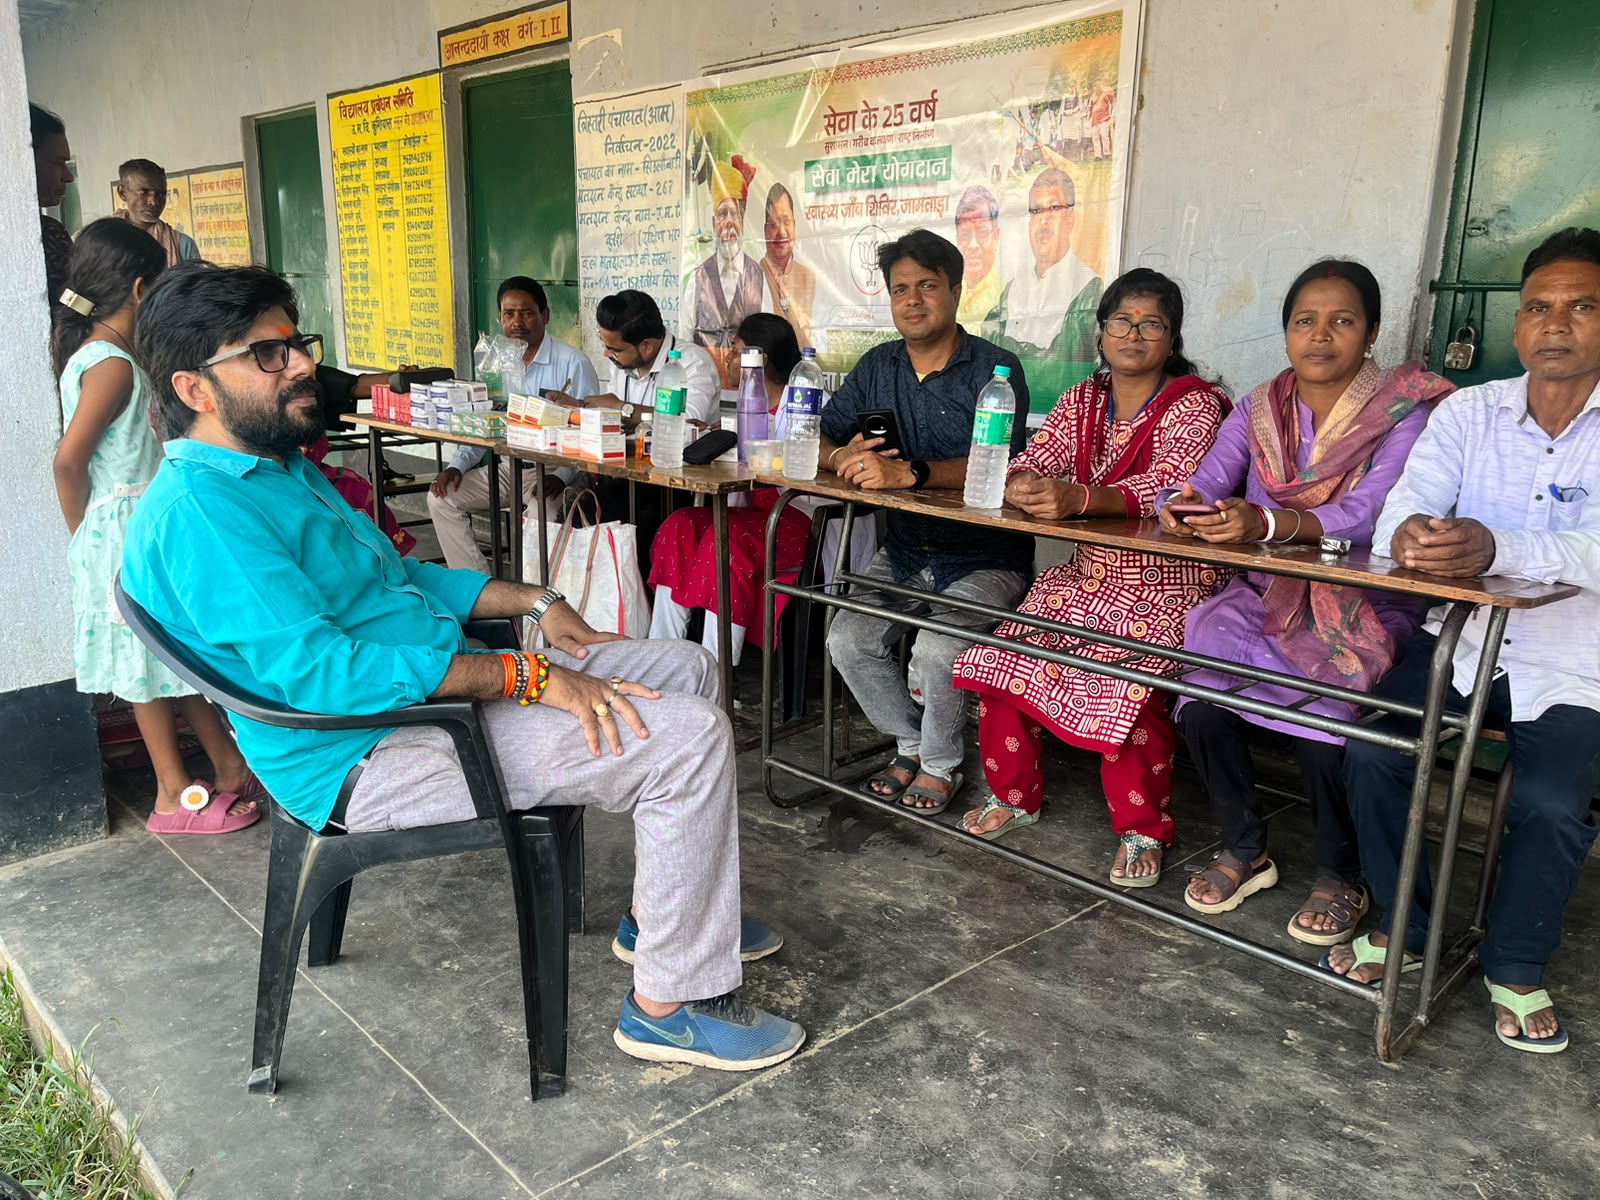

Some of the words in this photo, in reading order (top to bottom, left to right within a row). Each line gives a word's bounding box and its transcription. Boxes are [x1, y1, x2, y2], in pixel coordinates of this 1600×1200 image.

[445, 30, 489, 60] आनन्ददायी
[493, 28, 510, 49] कक्ष
[339, 100, 369, 121] विद्यालय
[371, 95, 392, 116] प्रबंधन
[824, 105, 858, 136] सेवा
[861, 100, 879, 131] के
[882, 103, 904, 129] 25
[909, 89, 938, 123] वर्ष
[825, 140, 848, 155] सुशासन
[852, 135, 869, 148] गरीब
[870, 135, 893, 146] कल्याण
[811, 165, 840, 188] सेवा
[846, 160, 877, 184] मेरा
[882, 156, 949, 181] योगदान
[656, 180, 674, 196] 267
[805, 203, 838, 221] स्वास्थ्य
